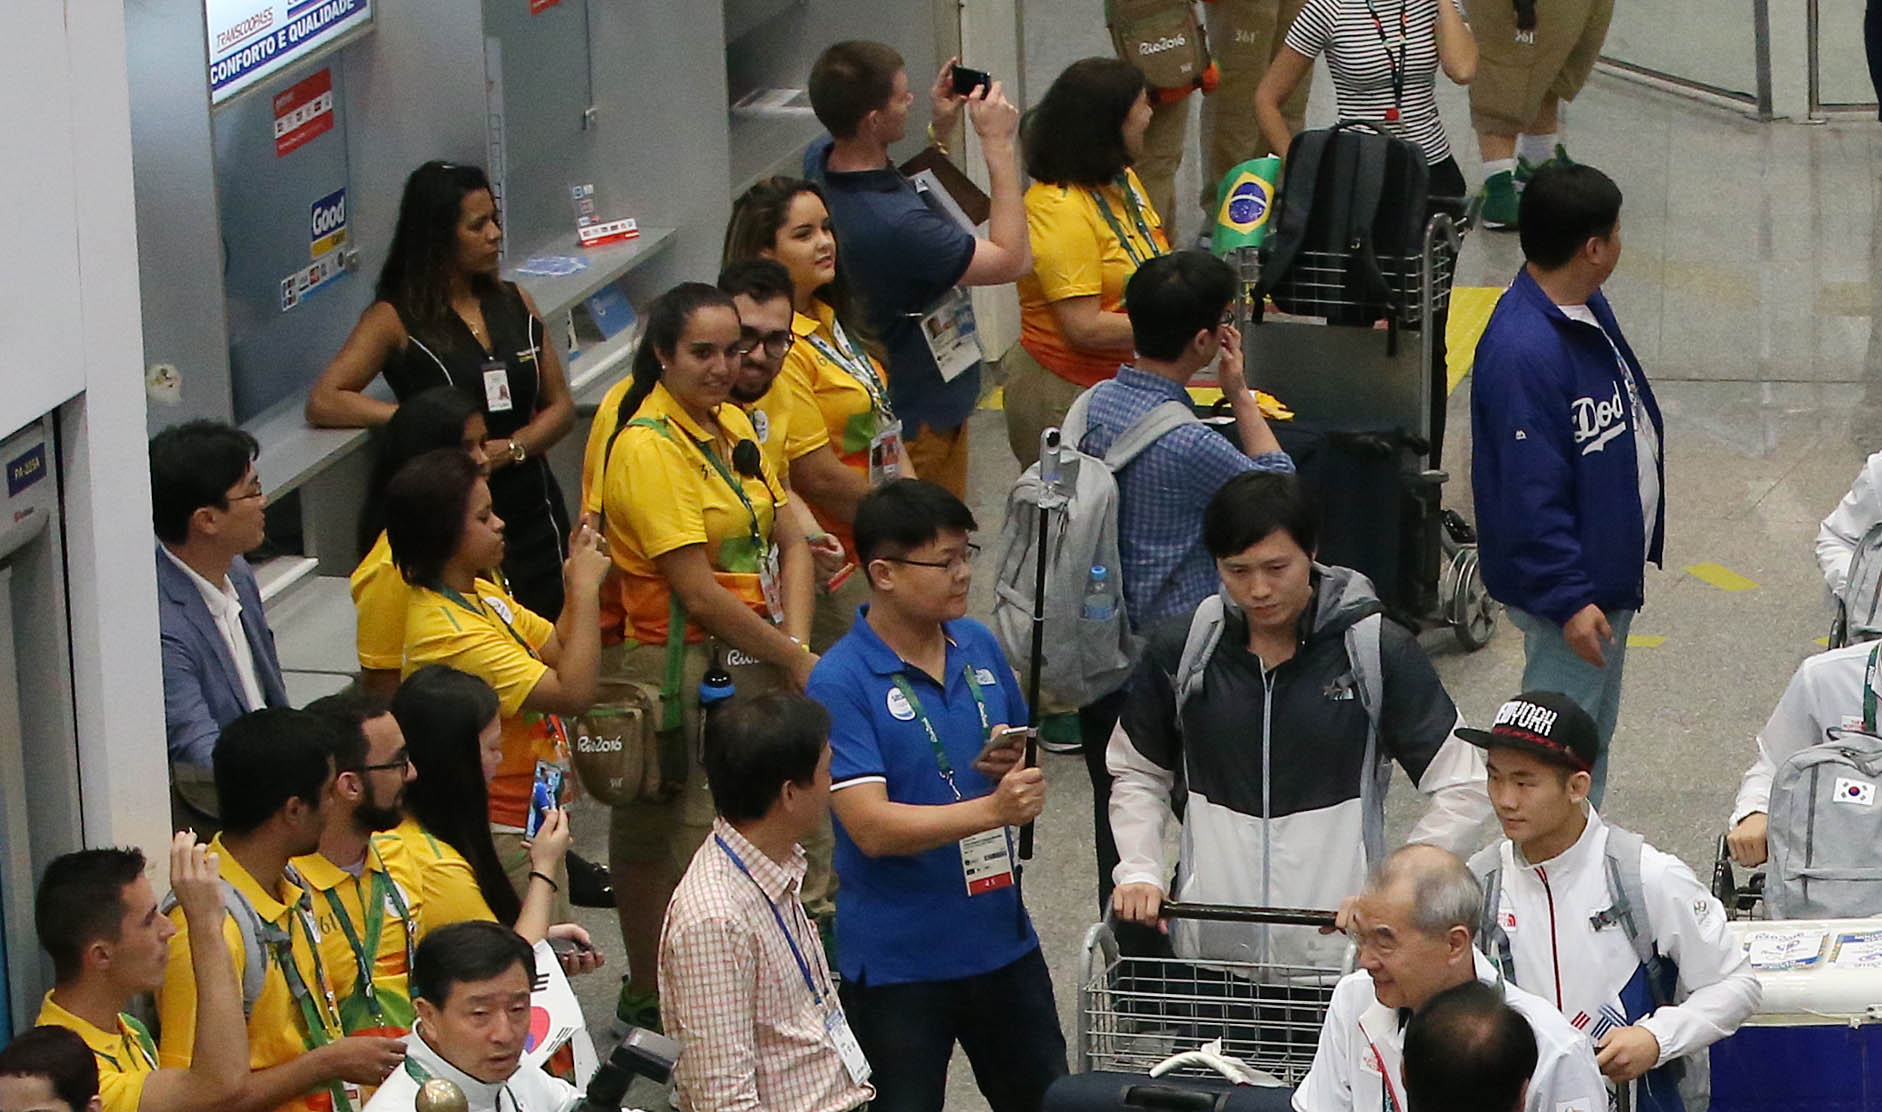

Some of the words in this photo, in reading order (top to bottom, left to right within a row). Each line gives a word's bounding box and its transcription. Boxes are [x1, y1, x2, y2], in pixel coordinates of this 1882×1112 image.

[210, 37, 276, 84] CONFORTO
[278, 31, 288, 48] E
[289, 0, 355, 43] QUALIDADE
[313, 196, 346, 236] Good
[578, 736, 623, 753] Rio2016
